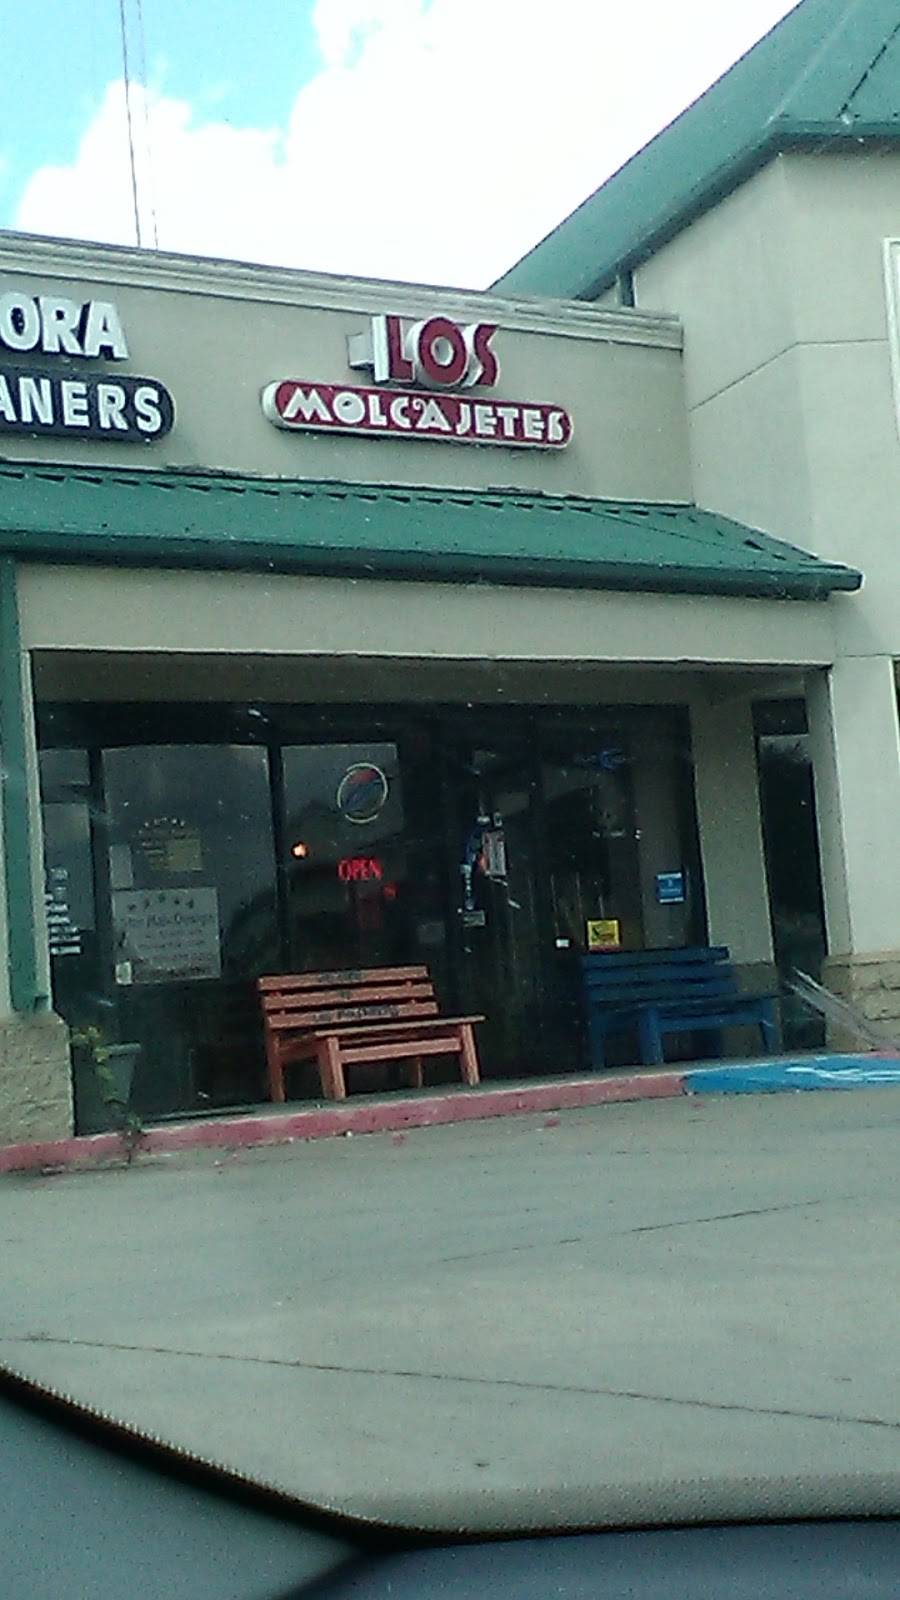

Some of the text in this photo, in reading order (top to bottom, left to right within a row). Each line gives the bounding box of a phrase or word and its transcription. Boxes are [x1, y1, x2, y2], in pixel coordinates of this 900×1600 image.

[0, 292, 129, 360] ORA
[372, 314, 500, 388] LOS
[282, 387, 564, 442] MOLCAJETES
[337, 856, 382, 880] OPEN
